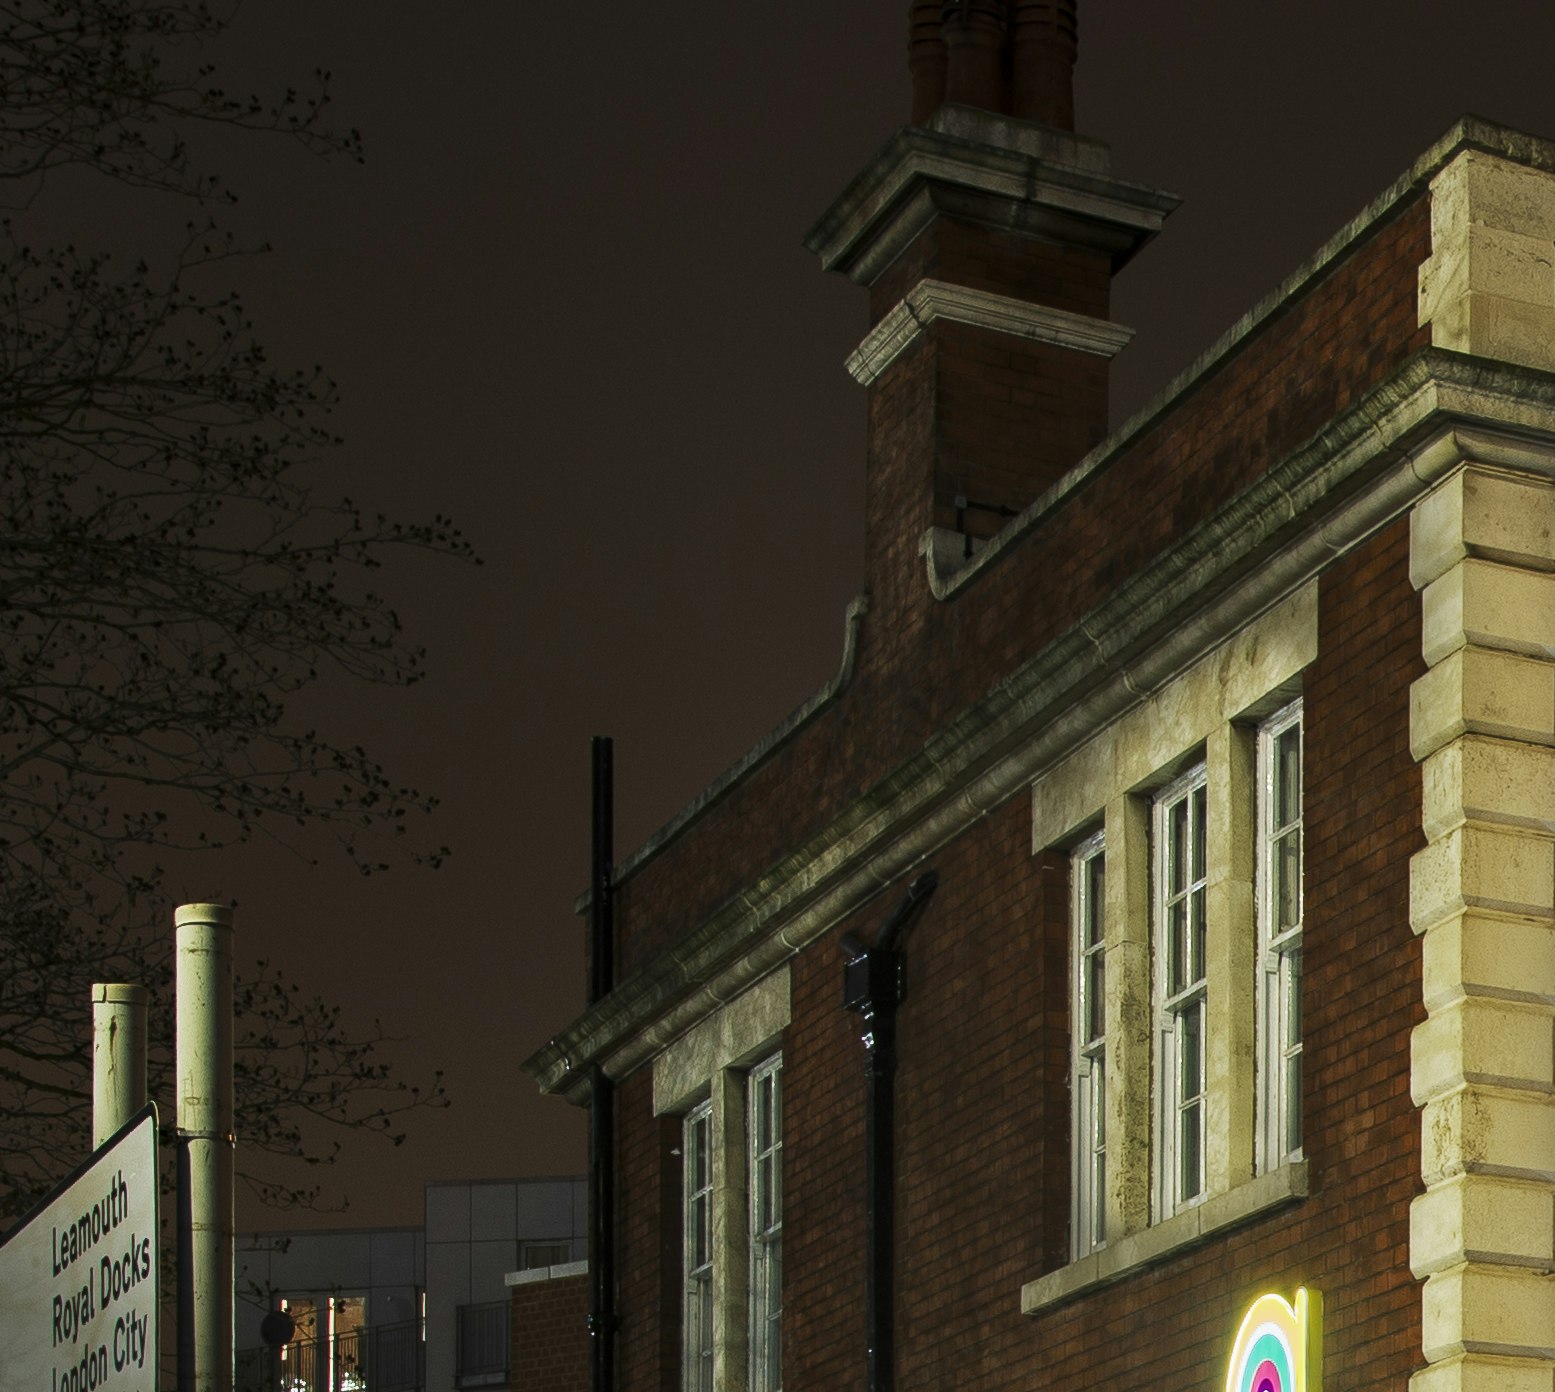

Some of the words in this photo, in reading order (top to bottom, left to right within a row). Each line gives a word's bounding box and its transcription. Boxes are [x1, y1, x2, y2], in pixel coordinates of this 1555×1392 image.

[53, 1170, 128, 1278] Leamouth
[53, 1267, 95, 1348] Royal
[101, 1233, 150, 1311] Docks
[113, 1309, 148, 1372] City
